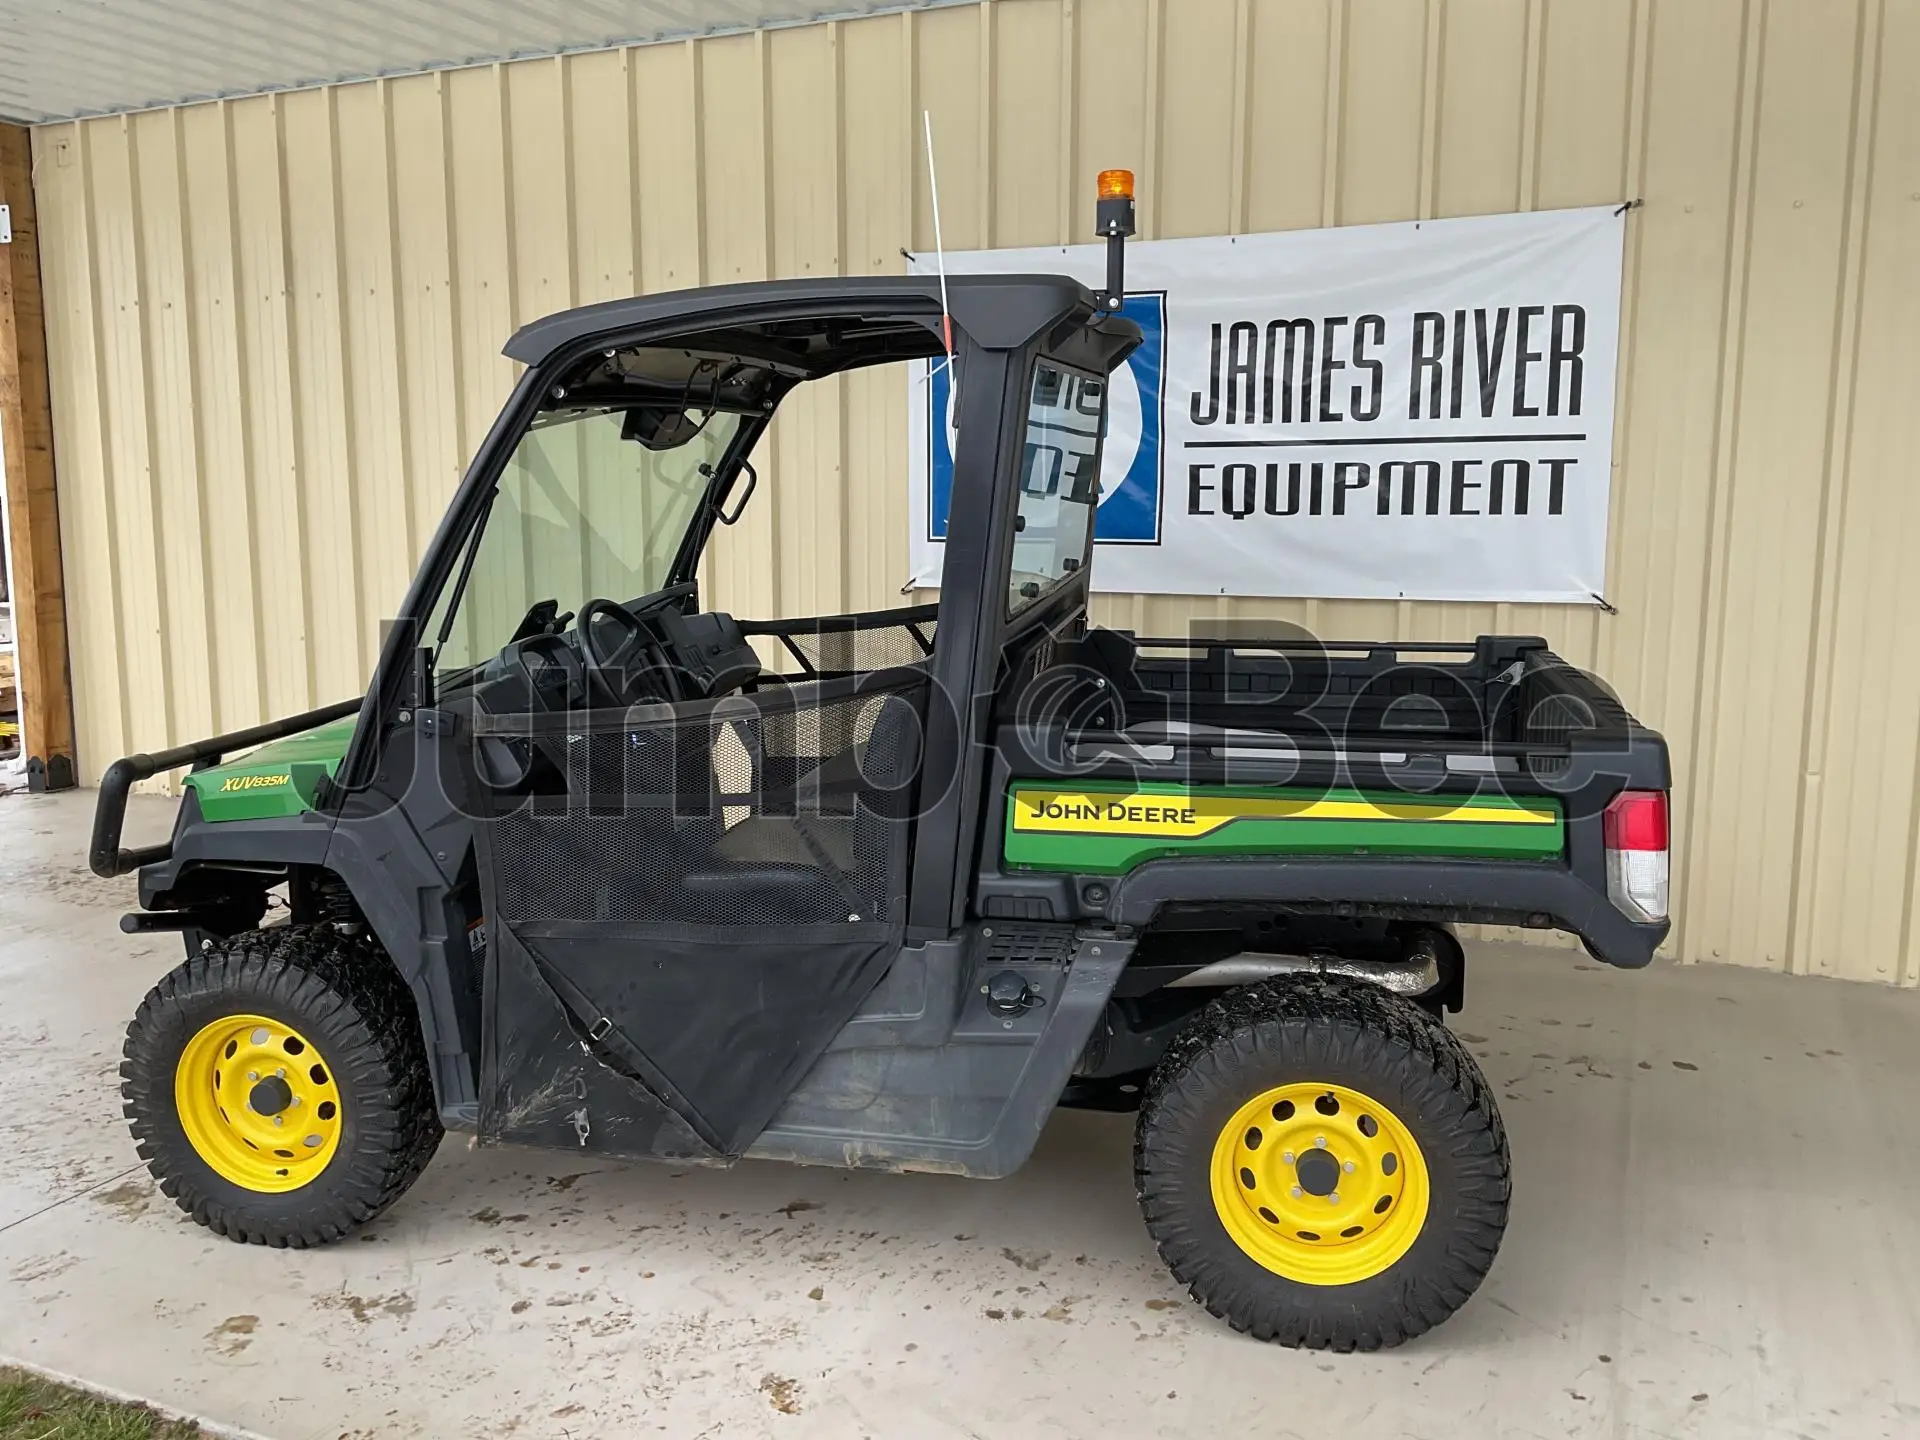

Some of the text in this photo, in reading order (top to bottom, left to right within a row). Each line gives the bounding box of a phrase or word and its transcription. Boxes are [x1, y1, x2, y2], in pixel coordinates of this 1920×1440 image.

[1191, 314, 1385, 425] JAMES
[1409, 304, 1586, 420] RIVER
[1188, 459, 1578, 520] EQUIPMENT
[220, 775, 291, 792] XUV835M
[1031, 800, 1196, 824] JOHN DEERE
